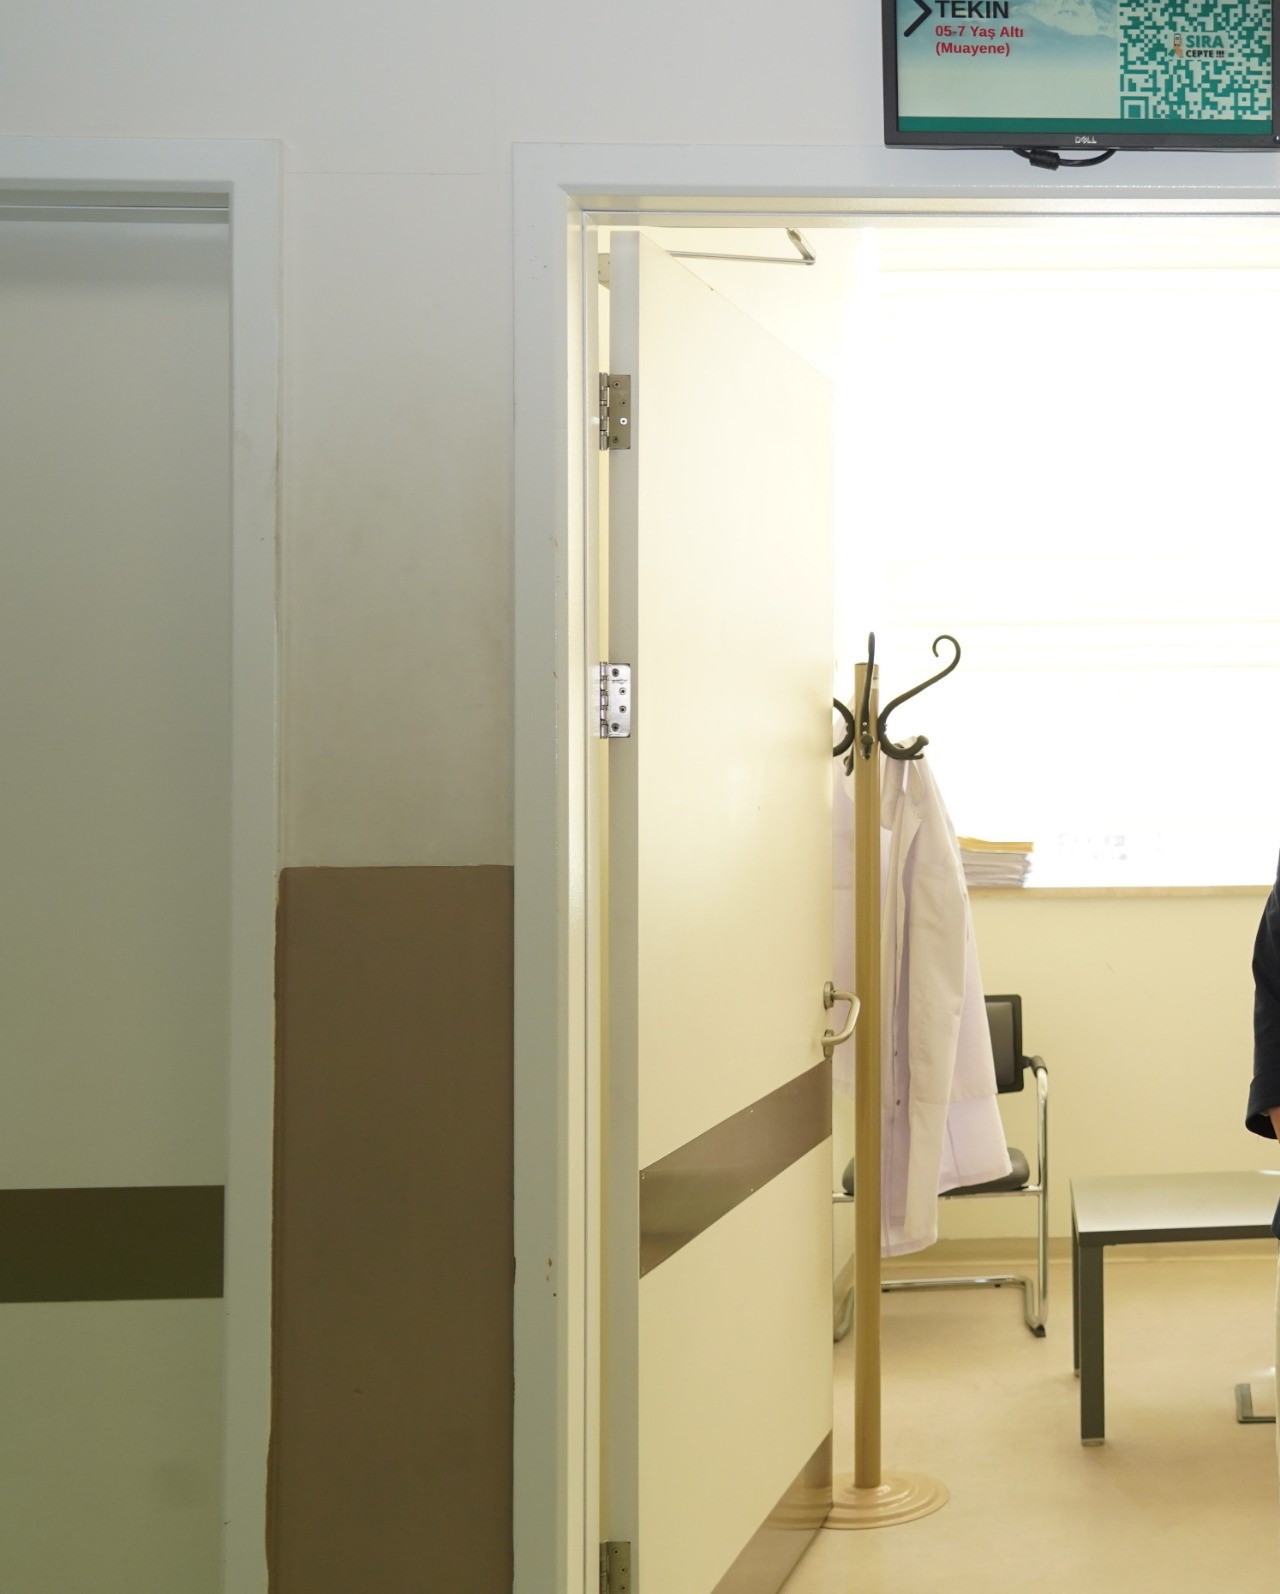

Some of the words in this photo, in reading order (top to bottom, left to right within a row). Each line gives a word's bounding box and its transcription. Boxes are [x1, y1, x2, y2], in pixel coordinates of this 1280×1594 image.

[935, 25, 966, 37] 05-7
[970, 26, 996, 40] Yaş
[999, 26, 1024, 38] Altı
[1186, 35, 1225, 48] SIRA
[936, 42, 1011, 57] (Muayene)
[1186, 50, 1214, 58] CEPTE
[1074, 136, 1097, 144] DELL
